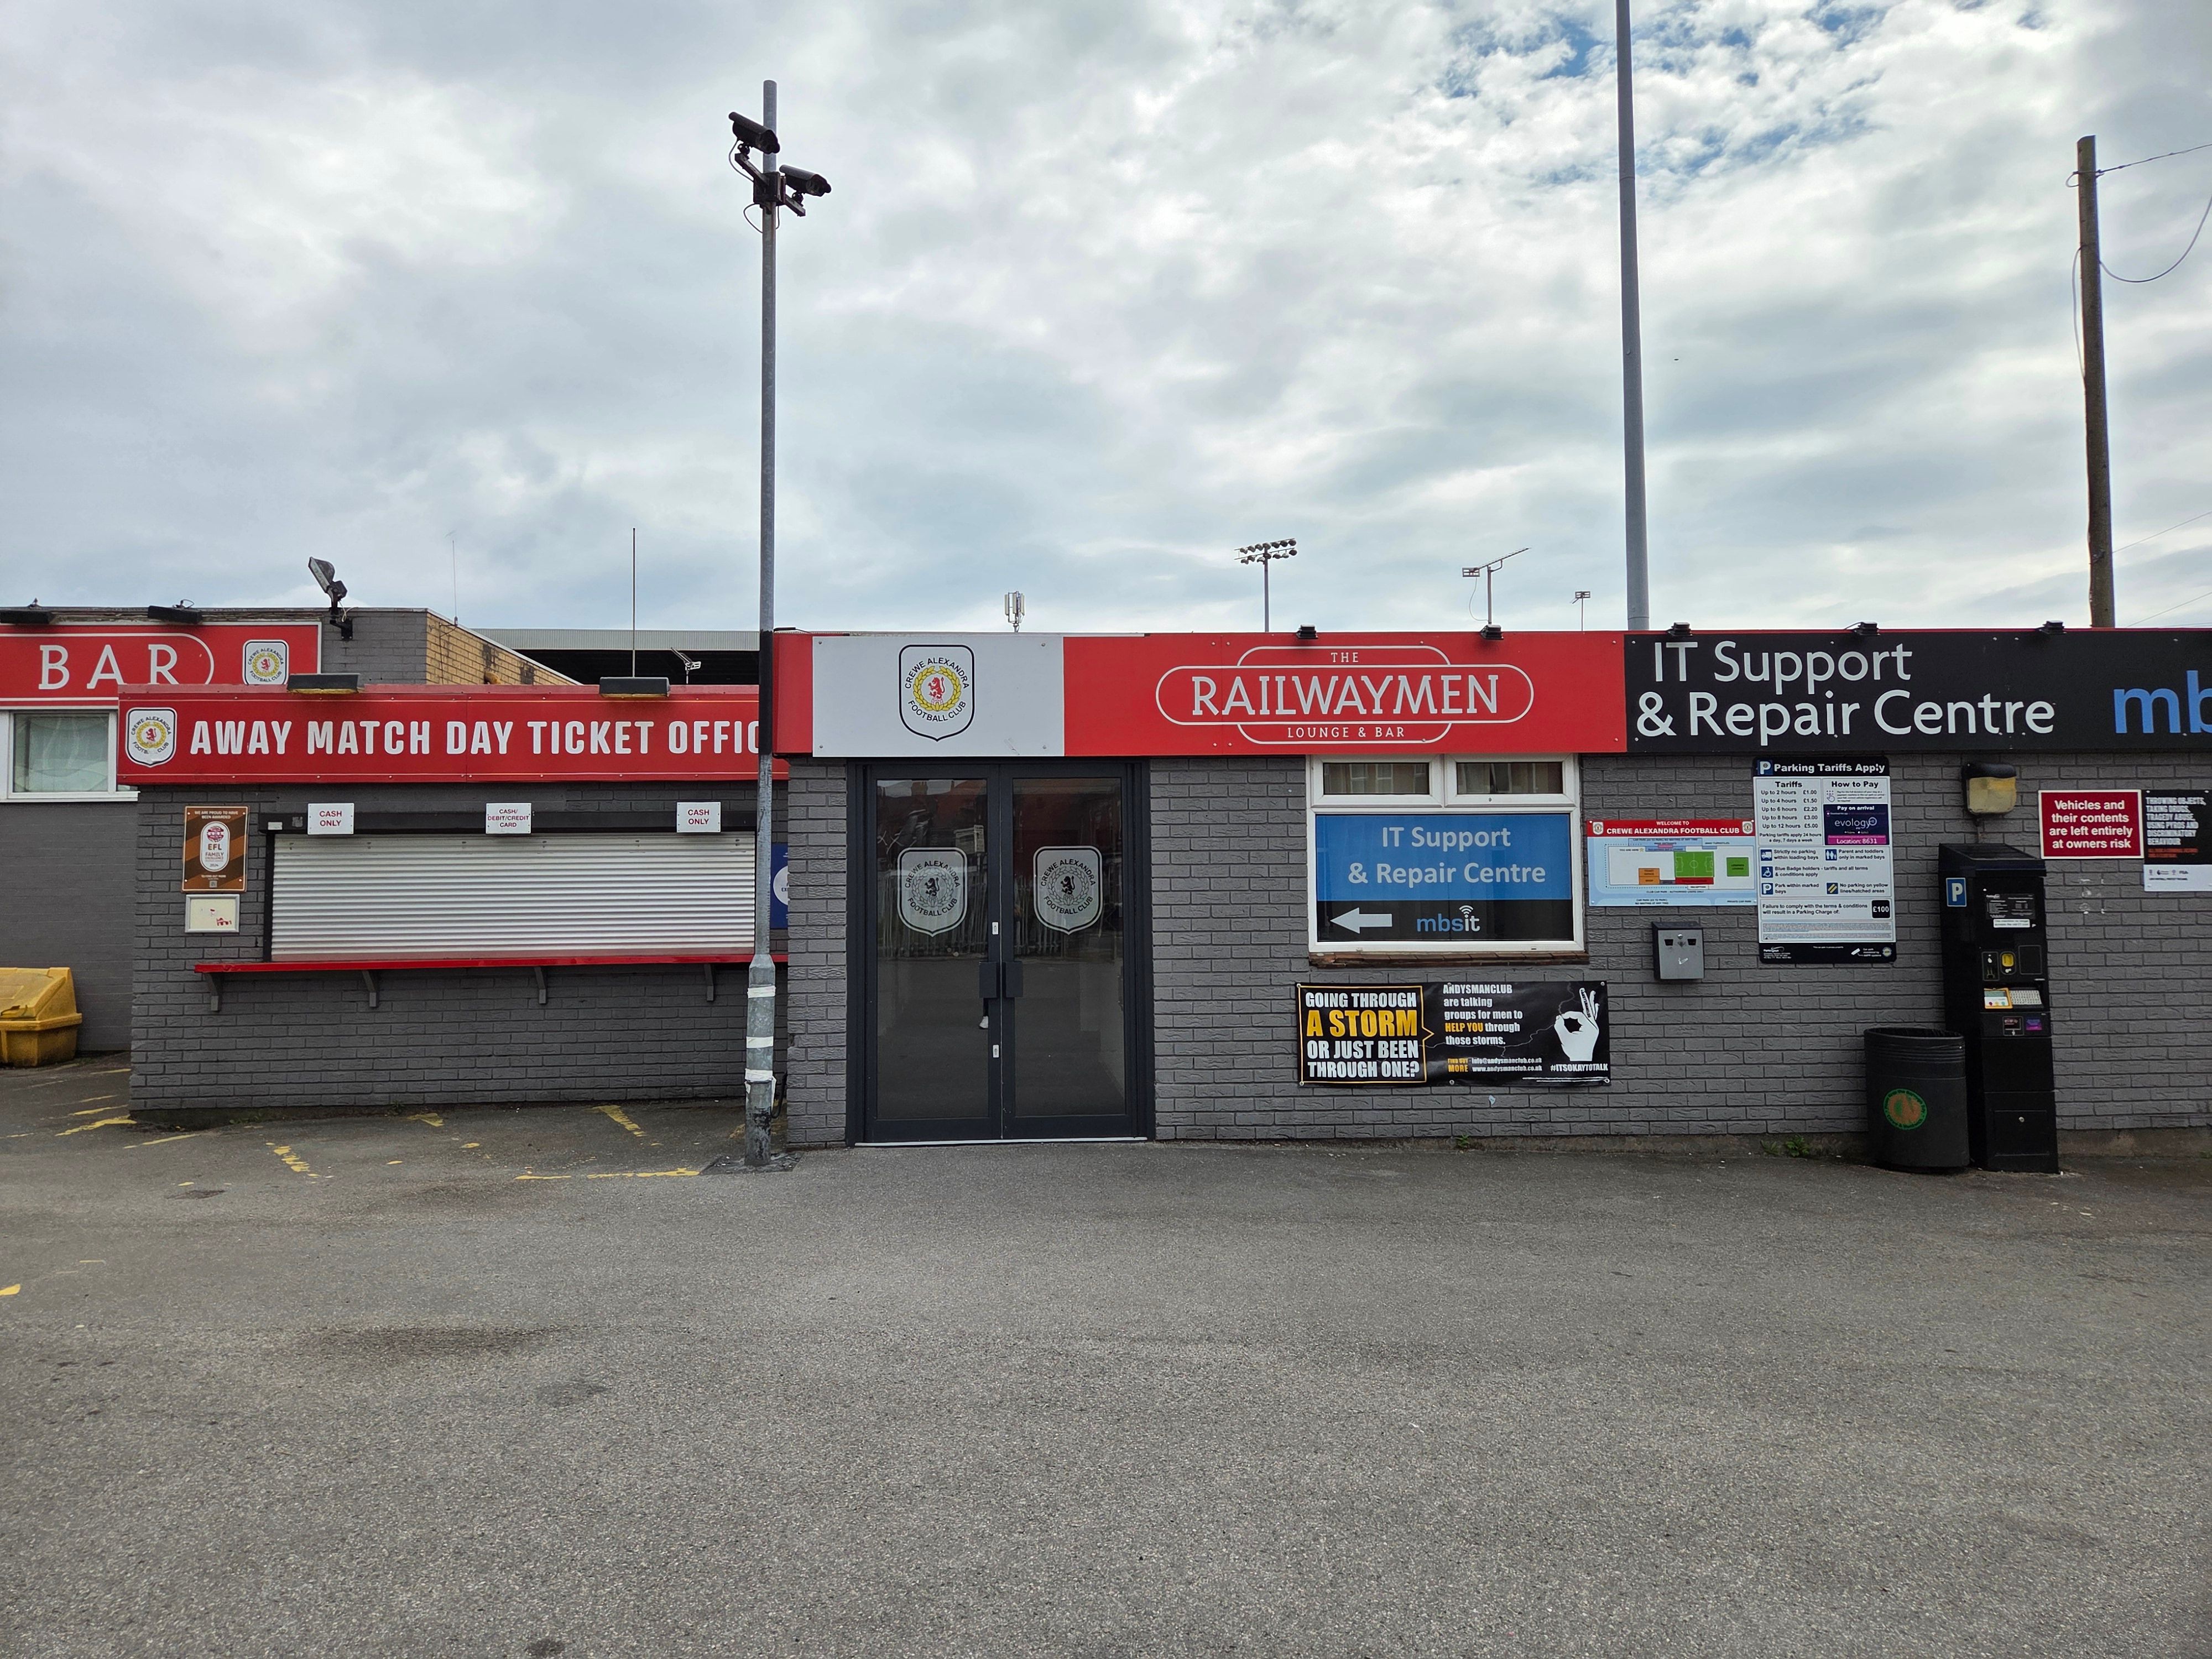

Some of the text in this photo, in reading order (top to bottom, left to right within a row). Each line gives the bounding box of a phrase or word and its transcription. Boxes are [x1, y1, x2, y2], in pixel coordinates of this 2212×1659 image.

[247, 648, 284, 665] CREWE ALEXANDRA
[1331, 652, 1360, 663] THE
[38, 644, 181, 690] BAR
[905, 657, 969, 689] CREWE ALEXANDRA
[1655, 640, 1913, 695] IT Support
[249, 670, 283, 682] FOOTBALL CLUB
[1192, 675, 1499, 716] RAILWAYMEN
[907, 700, 967, 722] FOOTBALL CLUB
[1637, 689, 2056, 746] & Repair Centre
[131, 716, 171, 735] CREWE ALEXANDRA
[1287, 726, 1405, 738] LOUNGE & BAR
[190, 720, 758, 755] AWAY MATCH DAY TICKET OFFIC
[157, 742, 170, 753] CLUB
[1774, 764, 1814, 773] Parking
[1817, 763, 1853, 771] Tariffs
[2054, 800, 2125, 810] Vehicles and
[2051, 813, 2130, 823] their contents
[1383, 826, 1511, 852] IT Support
[2049, 826, 2133, 838] are left entirely
[2052, 840, 2064, 848] at
[2110, 839, 2131, 848] risk
[905, 860, 961, 888] CREWE ALEXANDRA
[1040, 858, 1096, 886] CREWE ALEXANDRA
[1348, 862, 1546, 888] & Repair Centre
[1952, 883, 1963, 901] P
[906, 897, 958, 916] FOOTBALL CLUB
[1043, 895, 1094, 915] FOOTBALL CLUB
[1416, 912, 1480, 932] mbsit
[1443, 984, 1513, 994] ANDYSMANCLUB
[1306, 992, 1417, 1008] GOING THROUGH
[1443, 997, 1493, 1008] are talking
[1306, 1009, 1417, 1037] A STORM
[1444, 1010, 1523, 1021] groups for men to
[1445, 1022, 1520, 1033] HELP YOU through
[1445, 1035, 1506, 1045] those storms.
[1307, 1040, 1419, 1059] OR JUST BEEN
[1307, 1061, 1420, 1078] THROUGH ONE?
[1550, 1063, 1609, 1072] #ITSOKAYTOTALK
